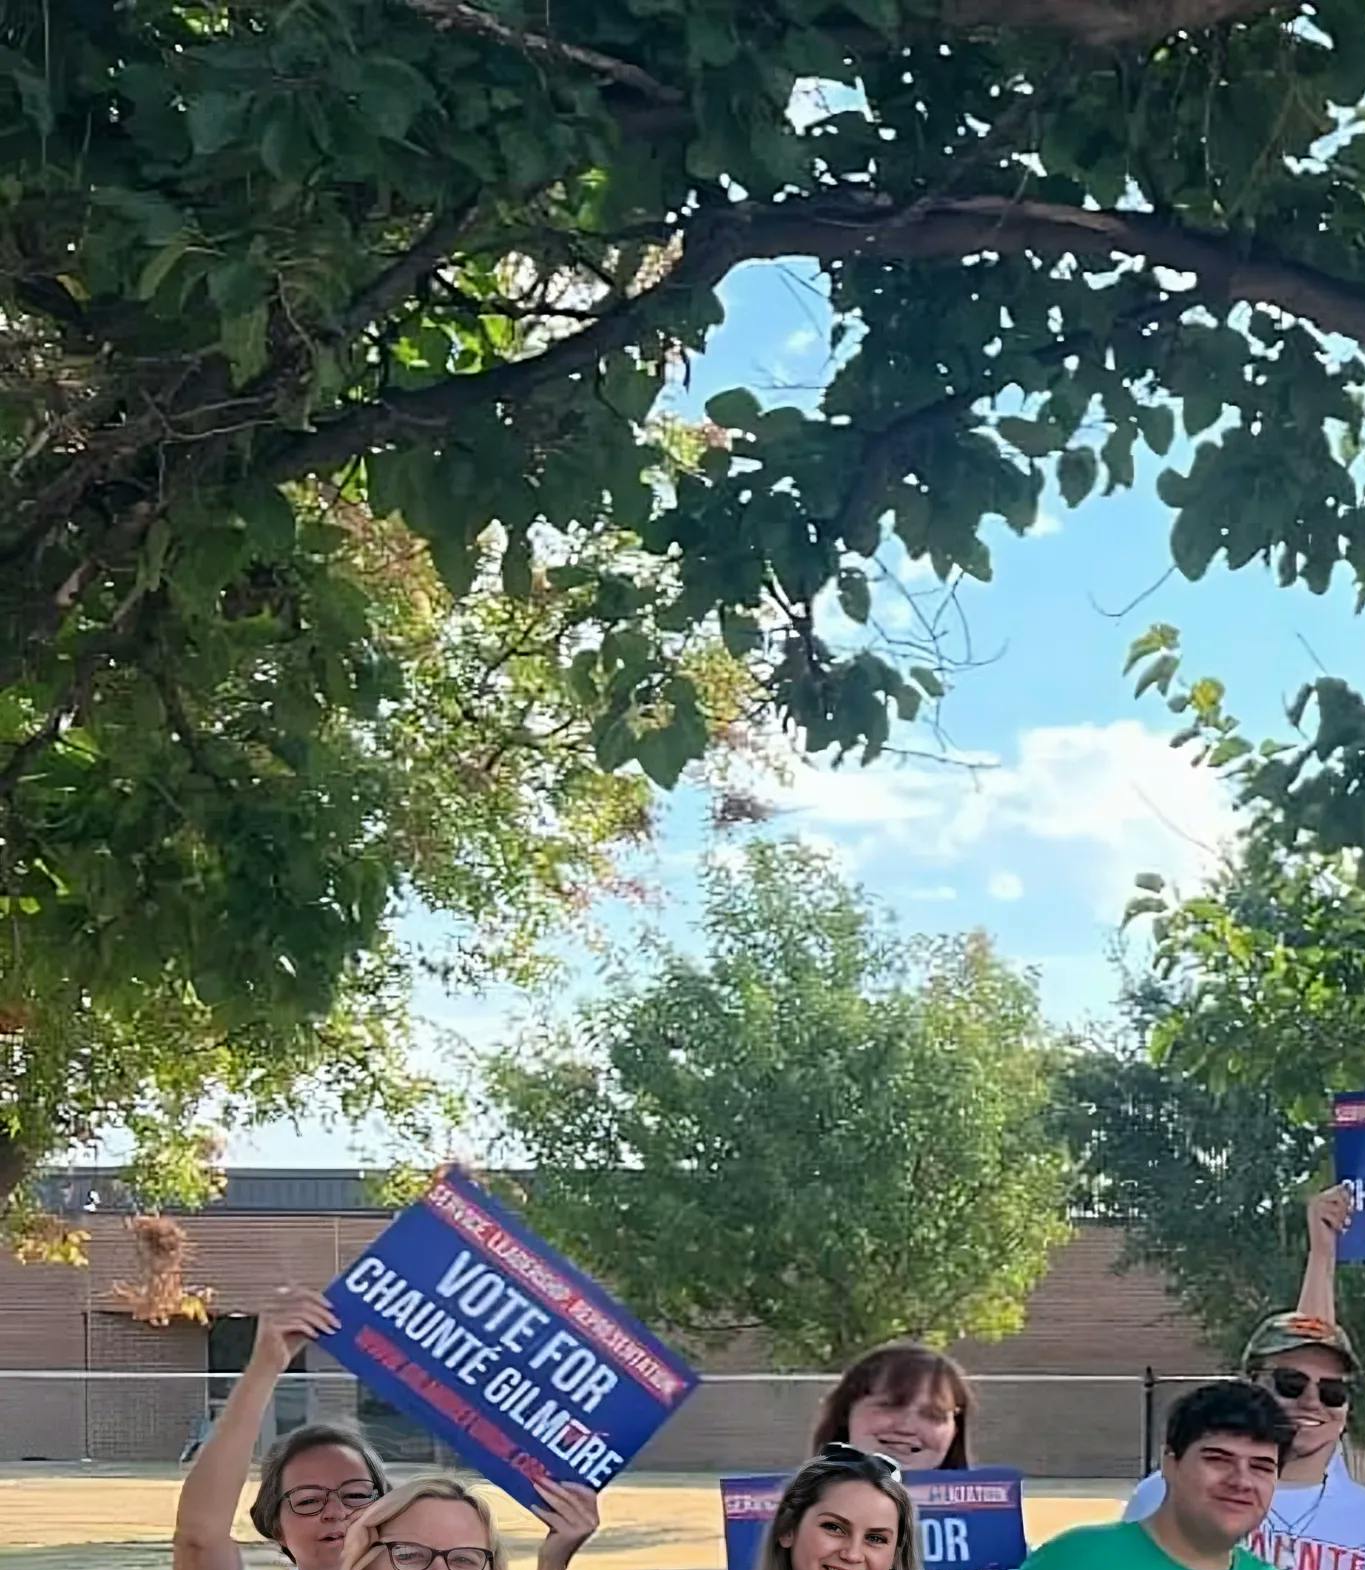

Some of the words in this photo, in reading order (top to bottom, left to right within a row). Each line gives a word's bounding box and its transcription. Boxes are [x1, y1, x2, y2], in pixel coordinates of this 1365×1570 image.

[345, 1257, 502, 1385] CHAUNTÉ
[483, 1367, 624, 1487] GILMORE
[436, 1250, 549, 1353] VOTE
[530, 1329, 618, 1413] FOR
[921, 1518, 970, 1562] OR
